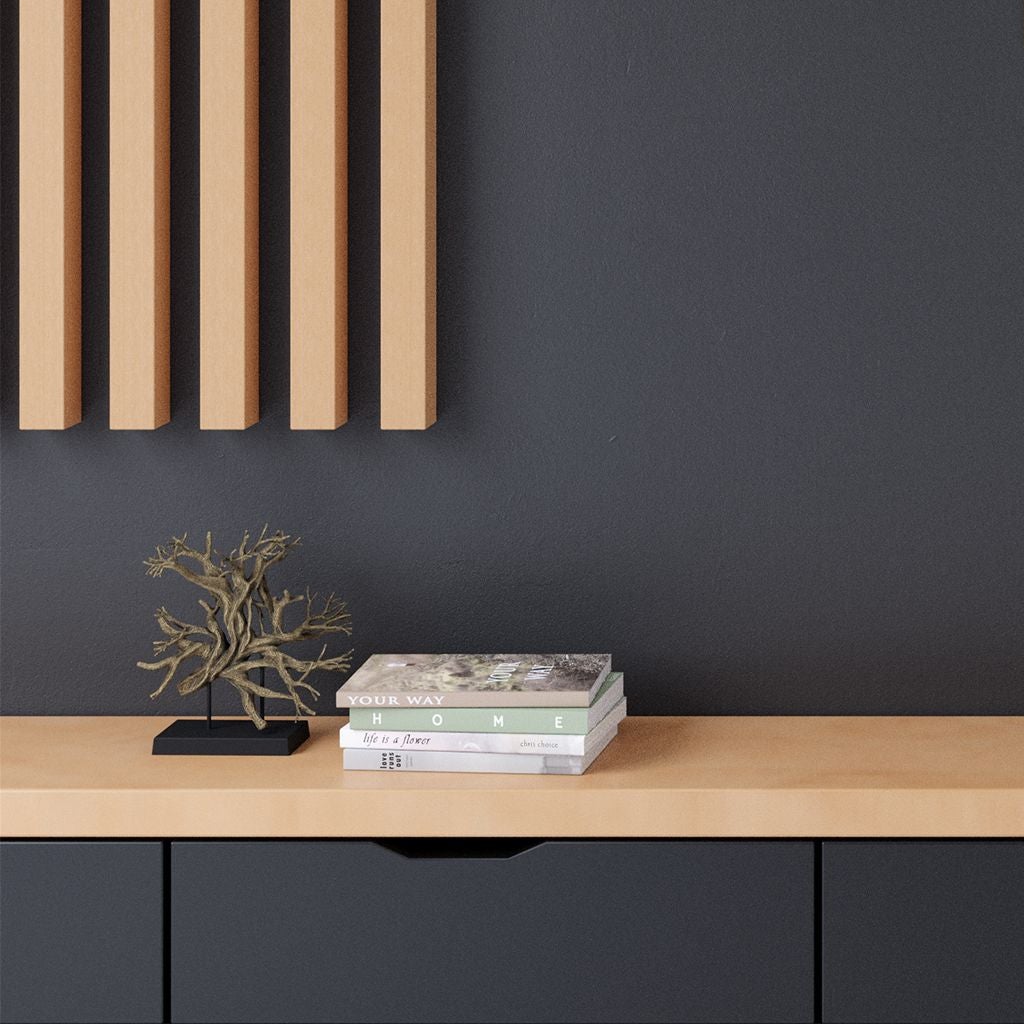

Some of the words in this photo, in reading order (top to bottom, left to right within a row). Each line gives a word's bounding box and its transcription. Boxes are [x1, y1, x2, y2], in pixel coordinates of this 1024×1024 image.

[486, 662, 521, 683] YOUR
[524, 664, 554, 681] WAY
[348, 695, 400, 705] YOUR
[406, 695, 445, 705] WAY
[372, 712, 563, 729] HOME
[363, 733, 379, 747] life
[382, 735, 390, 744] is
[400, 734, 431, 748] flower
[520, 739, 536, 748] chris
[537, 740, 559, 749] choice
[380, 752, 388, 769] love
